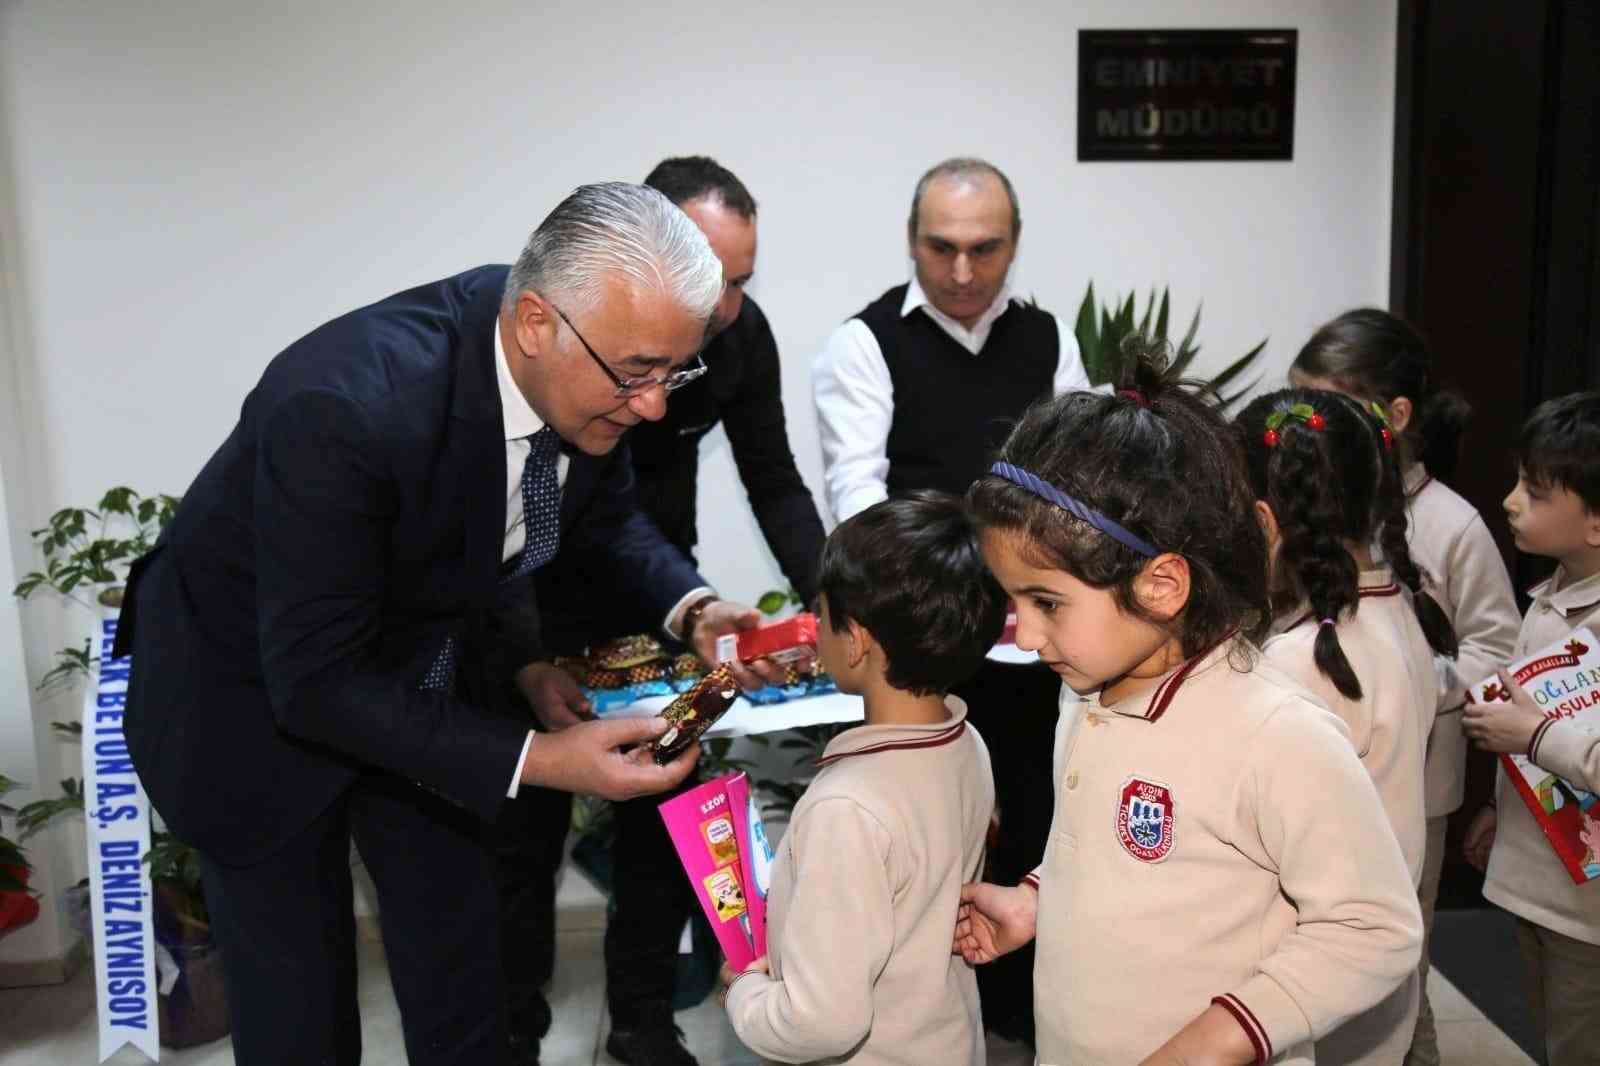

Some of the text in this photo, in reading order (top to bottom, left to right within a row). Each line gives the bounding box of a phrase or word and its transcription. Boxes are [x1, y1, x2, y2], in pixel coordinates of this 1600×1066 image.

[1137, 783, 1163, 797] AYDIN
[100, 840, 147, 913] DENİZ
[104, 919, 147, 1031] AYNISOY
